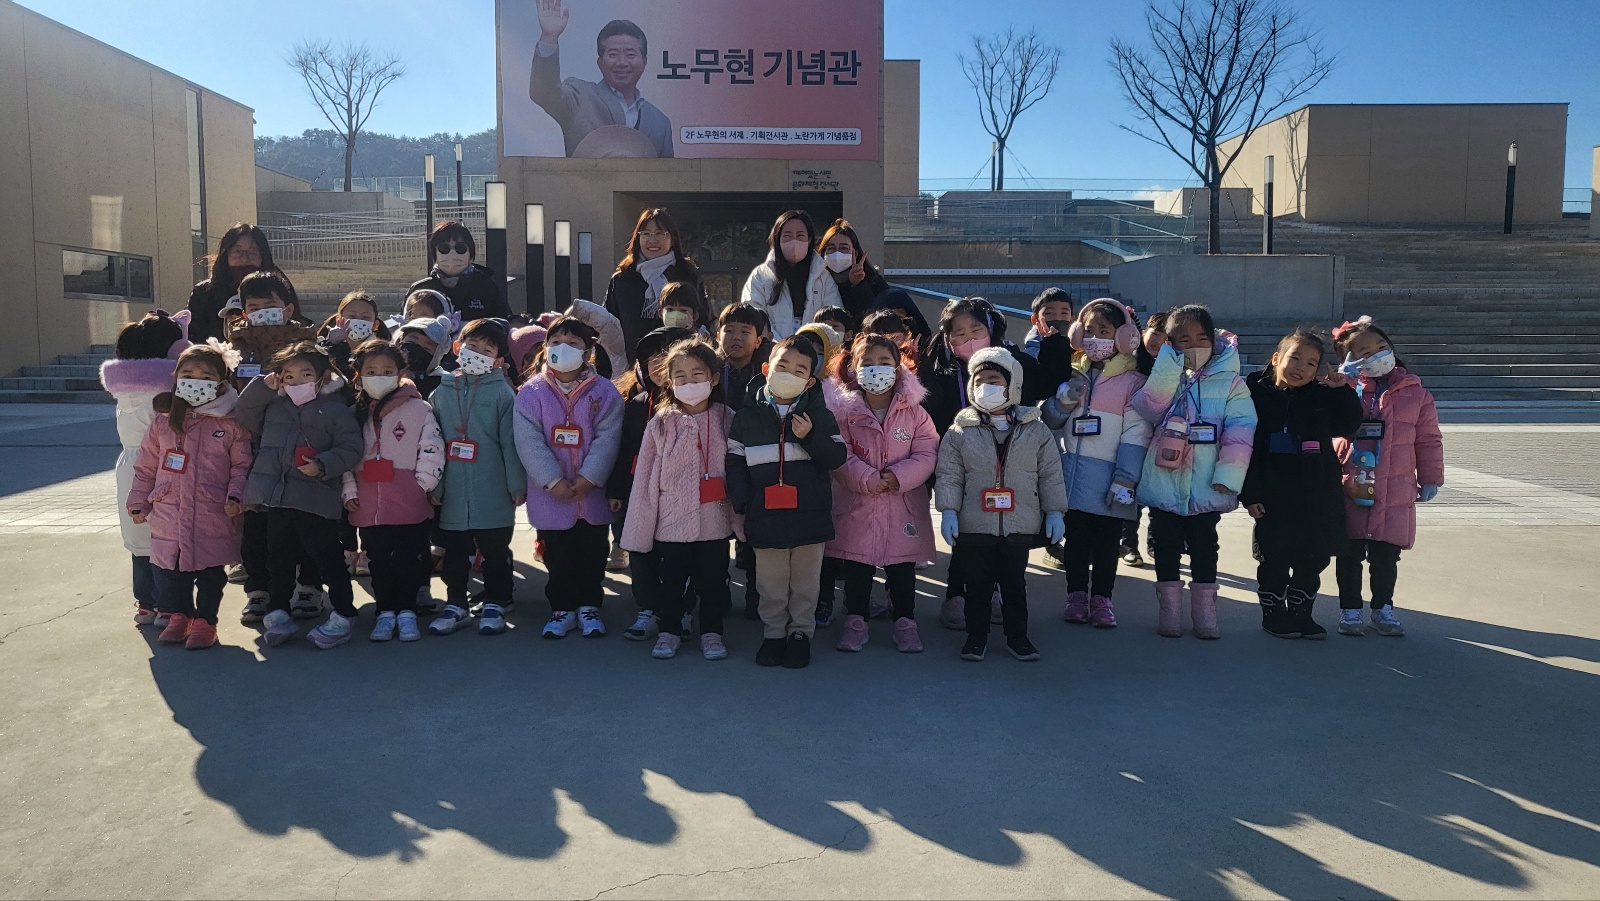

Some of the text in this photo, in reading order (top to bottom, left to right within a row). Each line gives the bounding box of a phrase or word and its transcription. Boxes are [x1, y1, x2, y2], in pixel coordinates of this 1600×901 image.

[656, 48, 862, 86] 노무현 기념관
[685, 129, 857, 142] 2F 노무현의 서재 기획전시관 노란가게 기념품점
